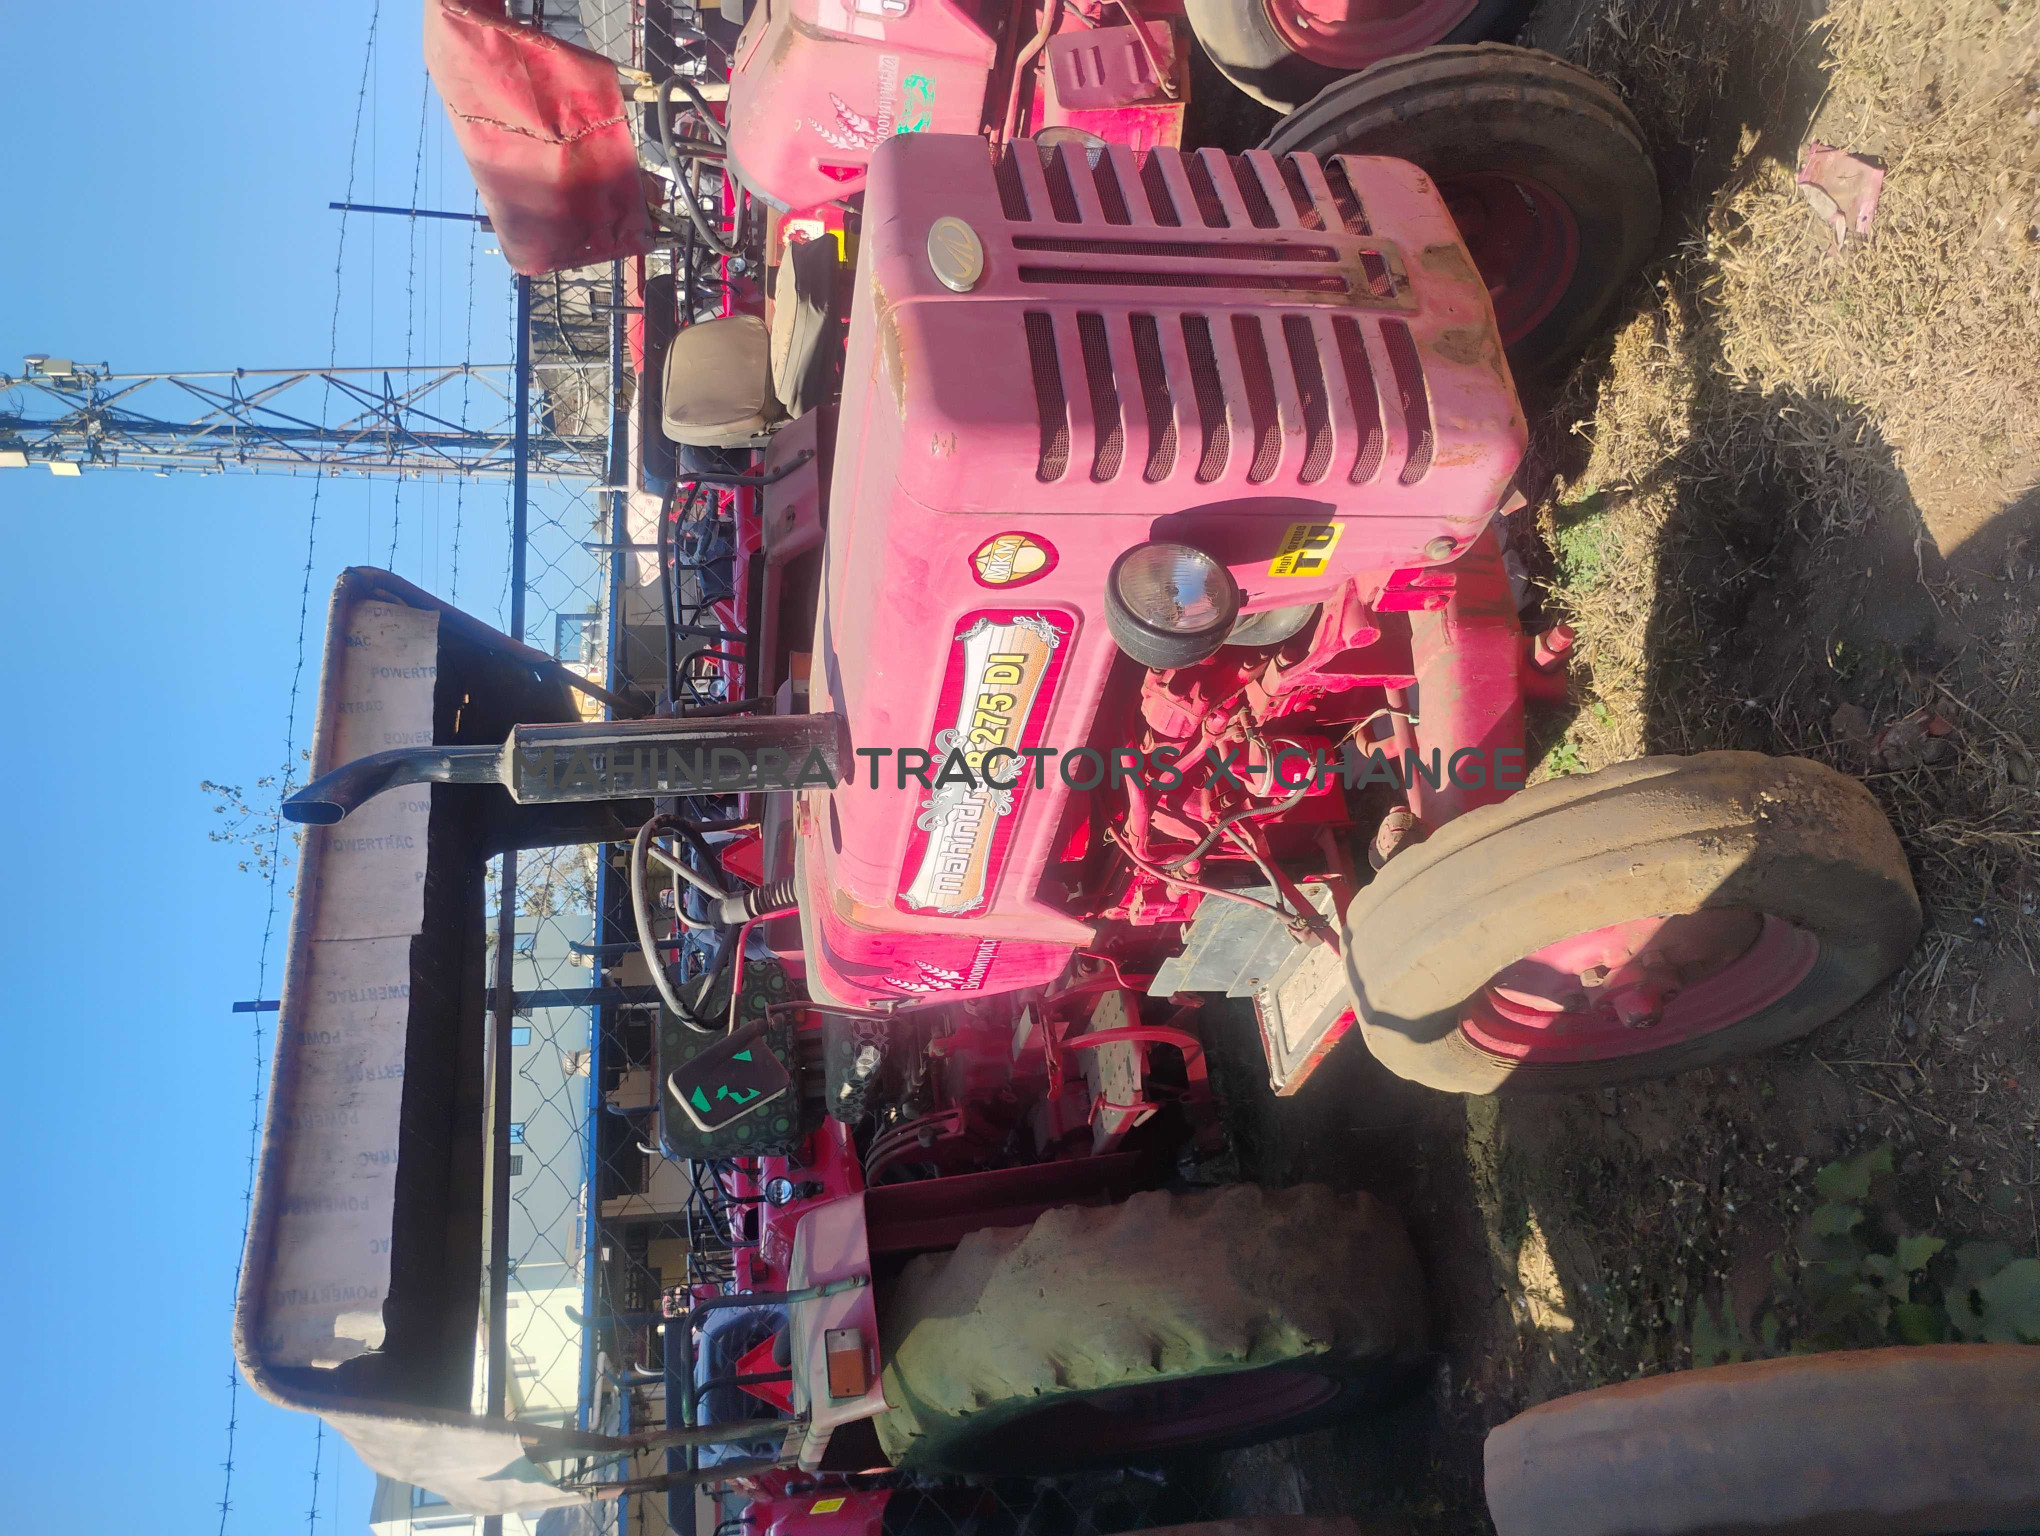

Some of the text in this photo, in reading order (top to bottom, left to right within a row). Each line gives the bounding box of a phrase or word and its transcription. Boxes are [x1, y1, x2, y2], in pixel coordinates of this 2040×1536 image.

[982, 539, 1020, 580] MKM
[1275, 526, 1306, 574] High Torque
[1291, 526, 1335, 574] TU
[981, 653, 1026, 685] DI
[968, 692, 1013, 746] 275
[934, 772, 990, 897] Mahindra
